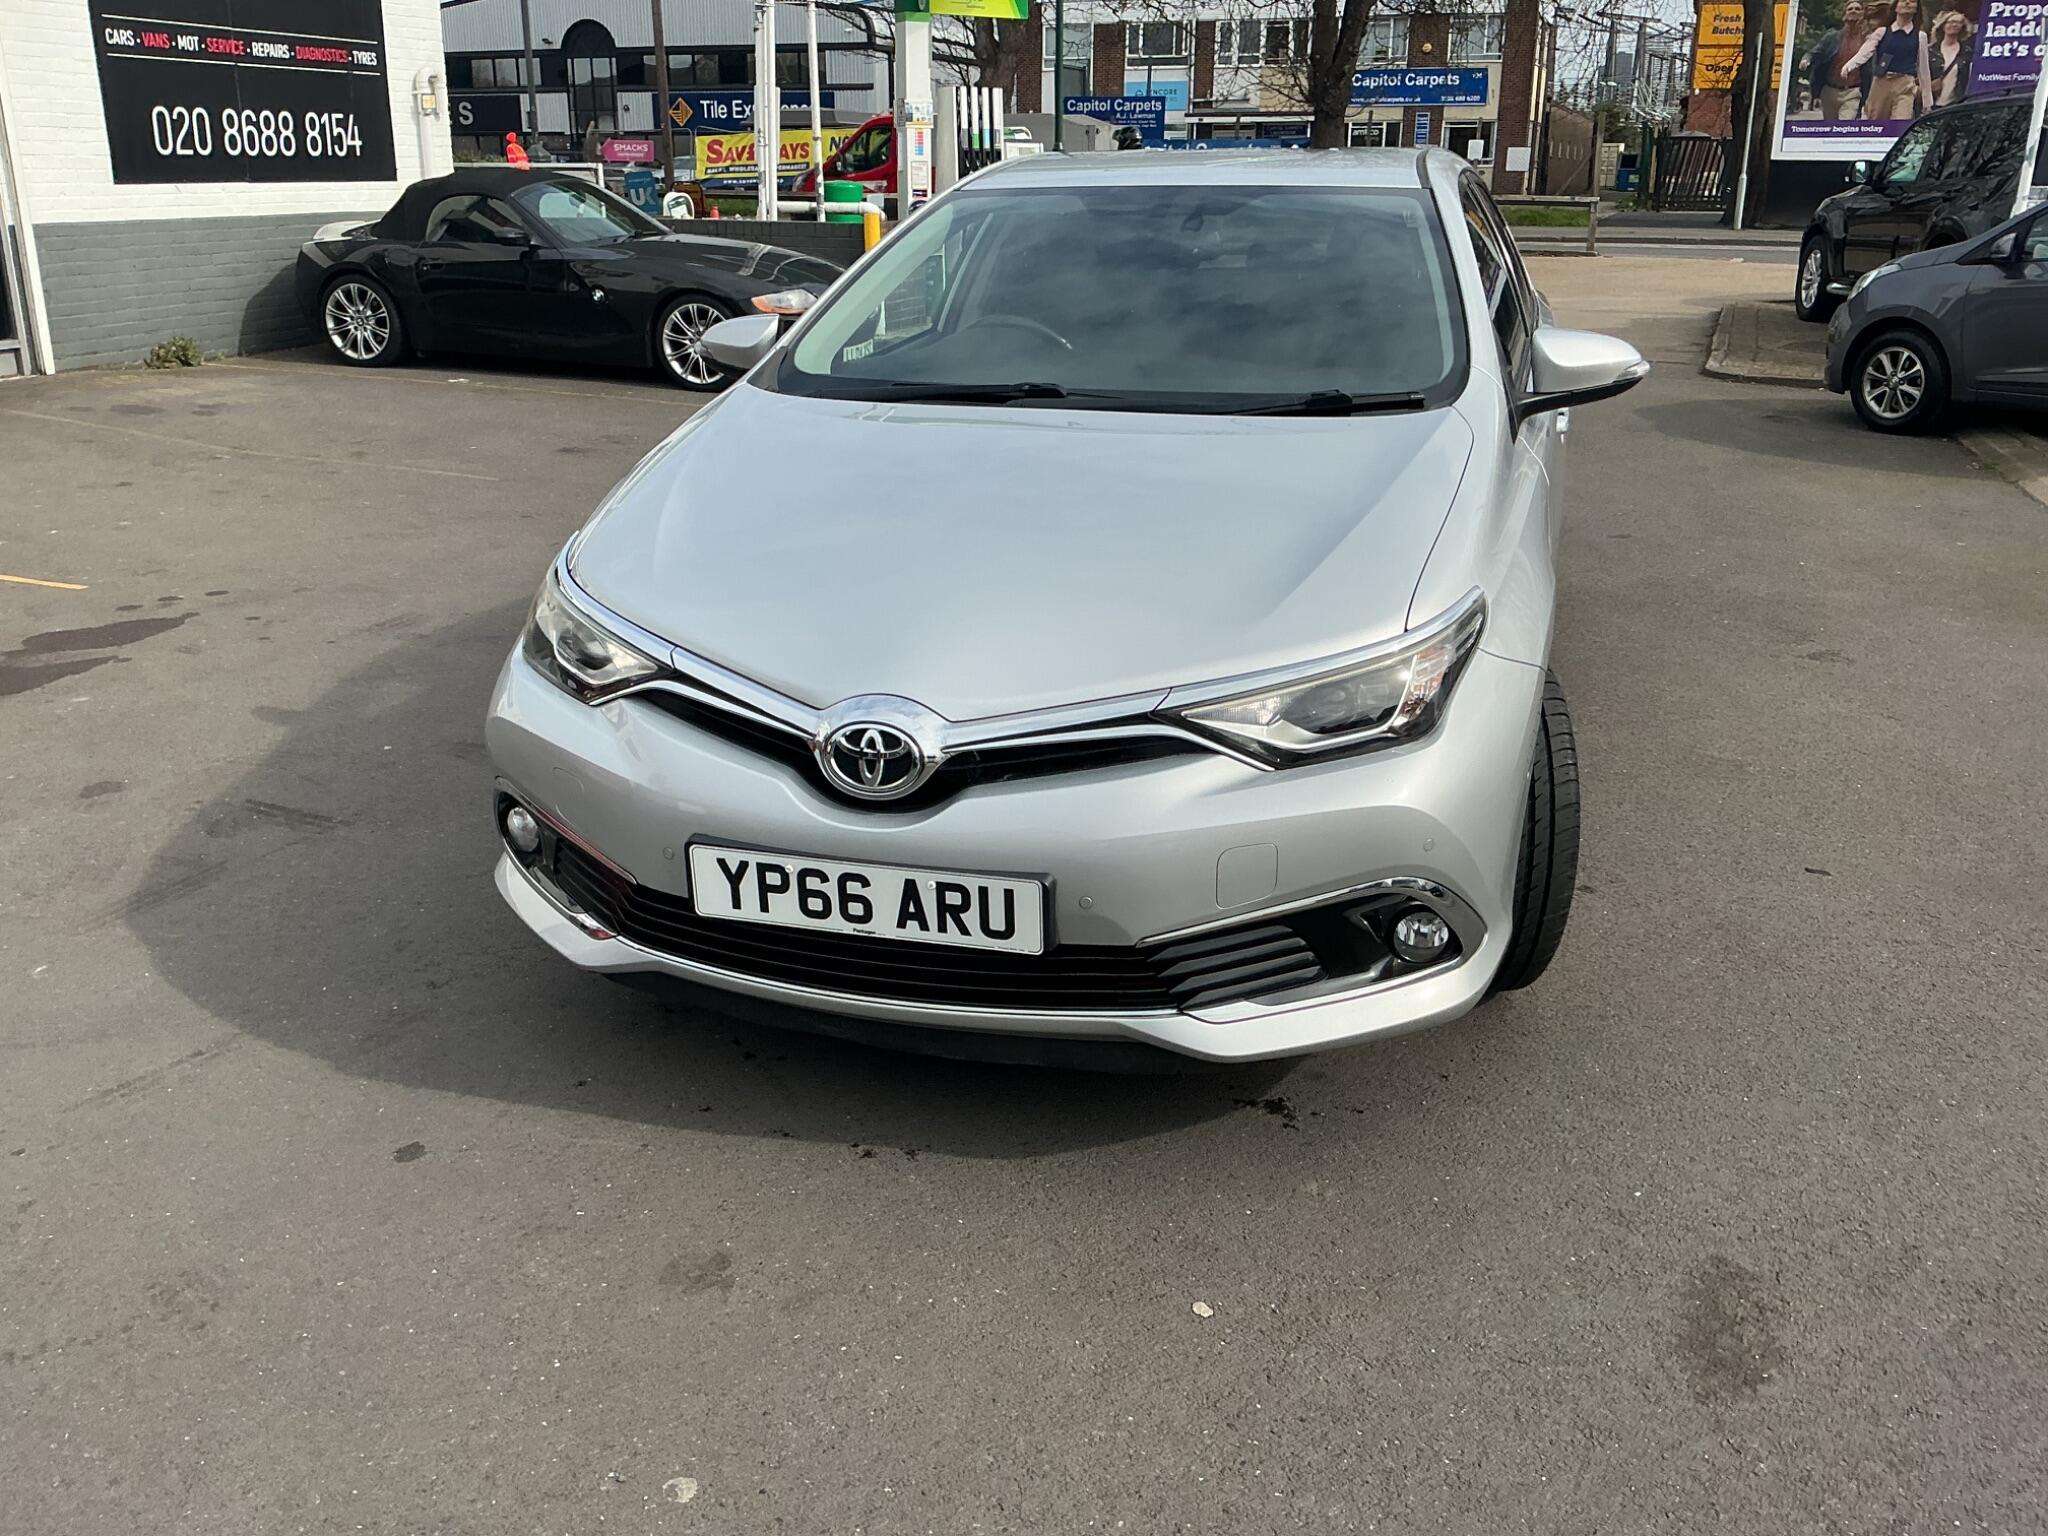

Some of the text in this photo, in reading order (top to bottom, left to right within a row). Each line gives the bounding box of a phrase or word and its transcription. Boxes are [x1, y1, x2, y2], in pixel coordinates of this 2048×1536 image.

[1712, 26, 1744, 34] Butch
[105, 28, 378, 66] CARS VANS MOT SERVICE REPAIRS DIAGNOSTICS TYRES
[1352, 73, 1401, 88] Capitol
[1405, 73, 1460, 88] Carpets
[1978, 73, 2012, 81] NatWest
[1152, 88, 1178, 96] NCORE
[700, 100, 727, 119] Tile
[1066, 99, 1162, 113] Capitol Carpets
[151, 105, 363, 157] 020 8688 8154
[1791, 125, 1884, 134] Tomorrow begins today
[716, 857, 1017, 941] YP66 ARU
